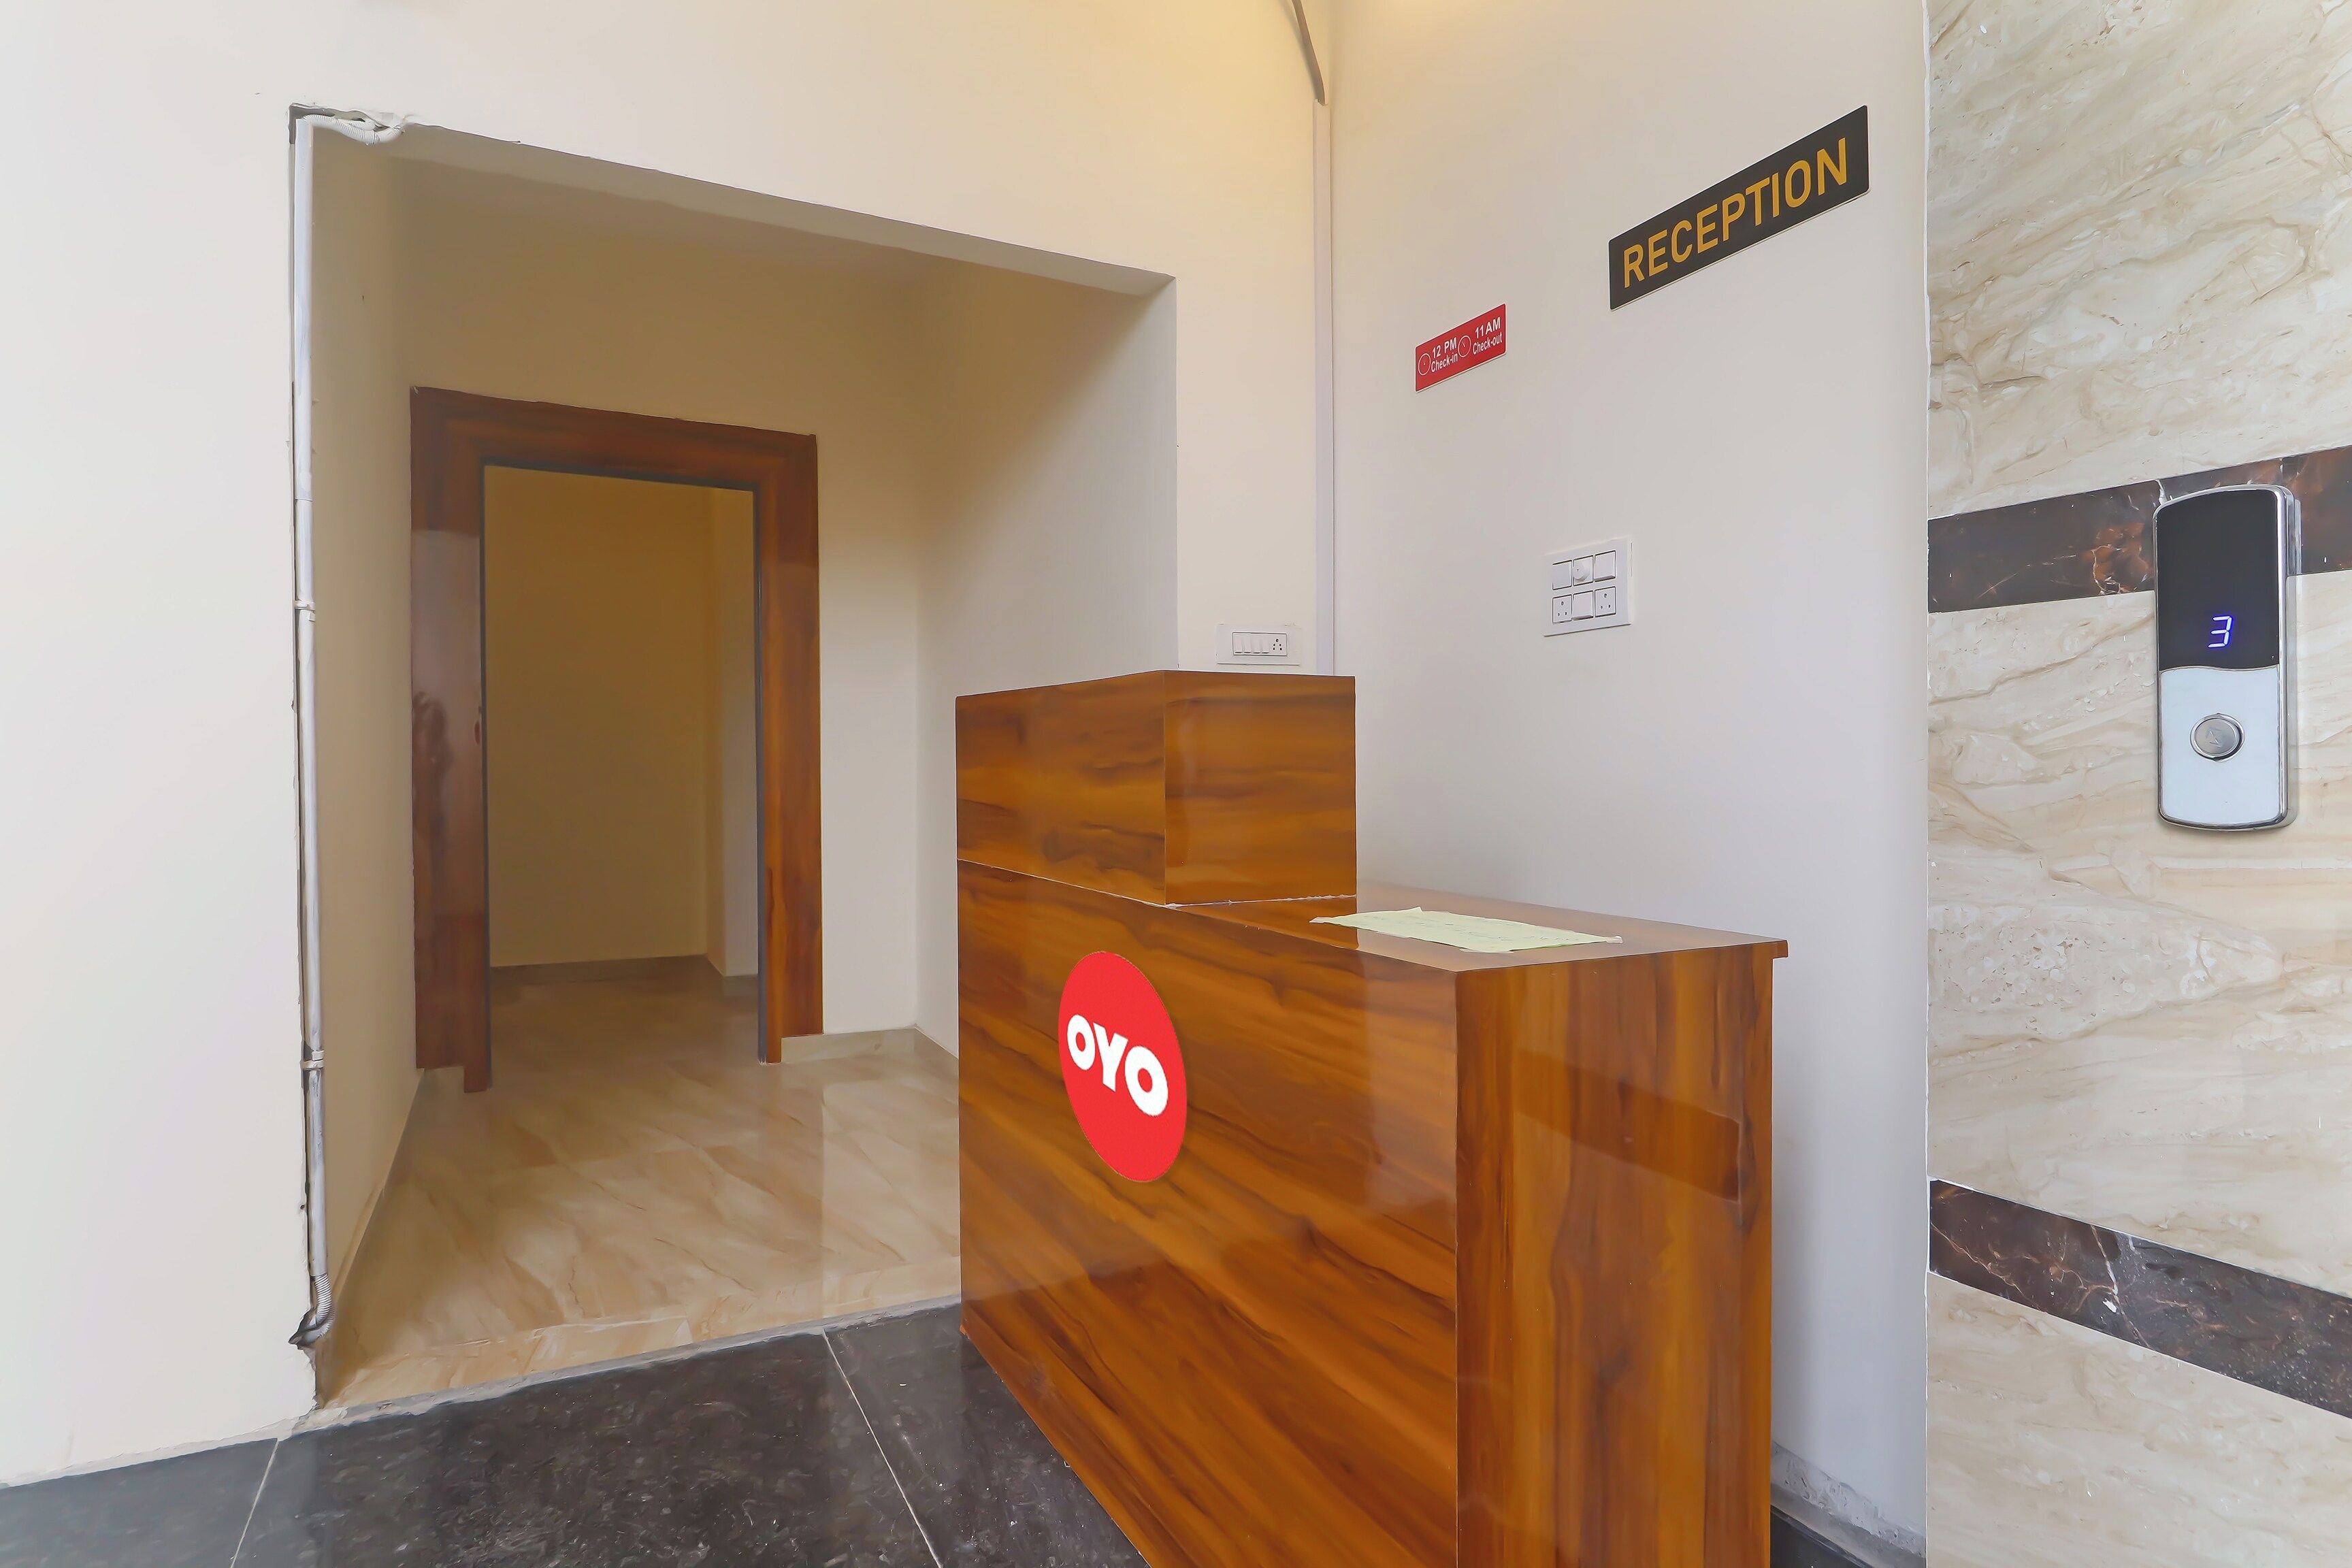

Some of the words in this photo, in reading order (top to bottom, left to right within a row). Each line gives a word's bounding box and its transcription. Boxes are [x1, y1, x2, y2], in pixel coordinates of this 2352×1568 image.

[1623, 137, 1847, 289] RECEPTION
[1475, 325, 1484, 338] 11
[1485, 316, 1501, 335] AM
[1432, 345, 1441, 359] 12
[1444, 337, 1457, 353] PM
[1473, 332, 1503, 355] Check-out
[1431, 353, 1458, 372] Check-in
[2208, 615, 2233, 648] 3
[1066, 1014, 1169, 1117] OYO
